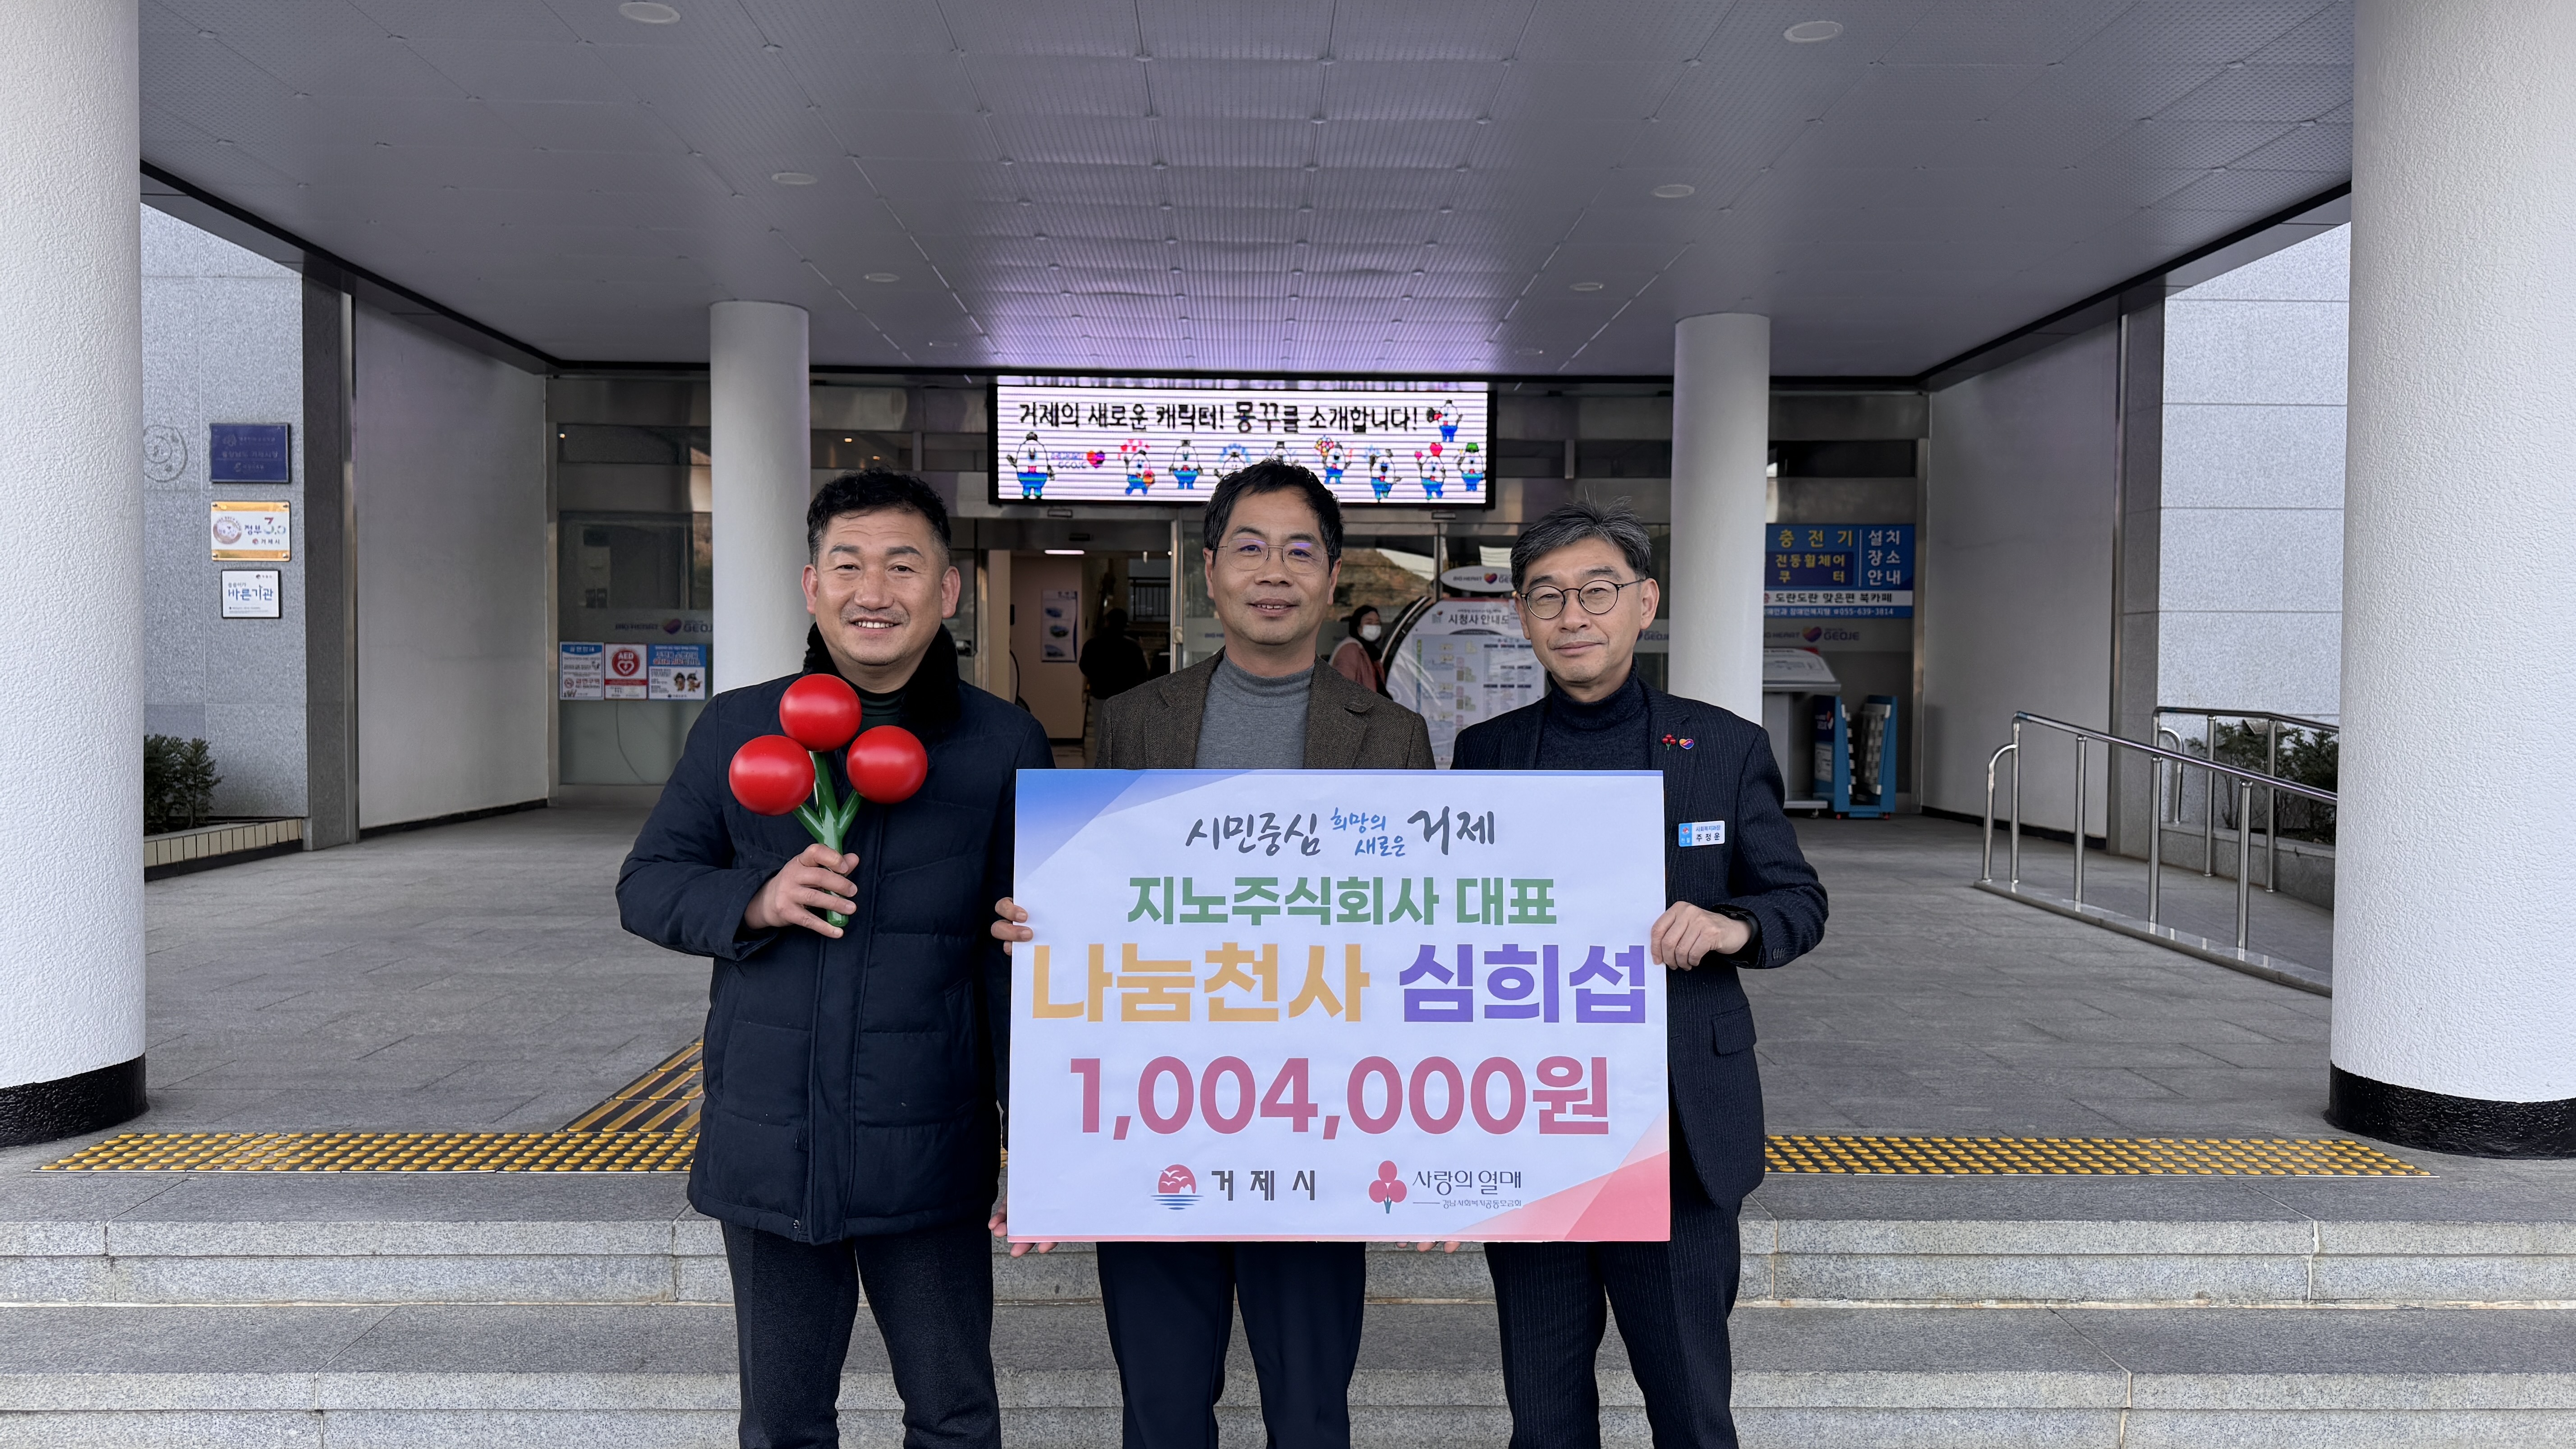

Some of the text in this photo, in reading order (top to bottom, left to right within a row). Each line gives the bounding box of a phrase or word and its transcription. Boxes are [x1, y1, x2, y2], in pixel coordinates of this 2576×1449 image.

[1020, 401, 1417, 433] 거제의 새로운 캐릭터! 몽꾸를 소개합니다!
[244, 524, 262, 535] 정부
[1868, 529, 1900, 547] 설치
[1775, 553, 1845, 568] 전동휠체어
[1868, 549, 1900, 567] 장소
[1868, 569, 1901, 586] 안내
[228, 584, 273, 601] 바른기관
[1775, 593, 1818, 604] 도란도란
[1822, 593, 1855, 604] 맞은편
[1859, 593, 1892, 603] 북카페
[683, 622, 713, 633] GEOJ
[1448, 614, 1479, 625] 시청사
[1481, 614, 1509, 625] 안내도
[1823, 631, 1860, 641] GEOJE
[618, 652, 634, 660] AED
[1330, 807, 1386, 833] 희망의
[1185, 812, 1320, 856] 시민중심
[1407, 805, 1495, 856] 거제
[1355, 835, 1406, 857] 새로운
[1127, 876, 1557, 926] 지노주식회사 대표
[1032, 942, 1646, 1024] 나눔천사 심희섭
[1070, 1055, 1609, 1140] 1,004,000원
[1211, 1170, 1316, 1201] 거제시
[1412, 1170, 1521, 1196] 사랑의 열매
